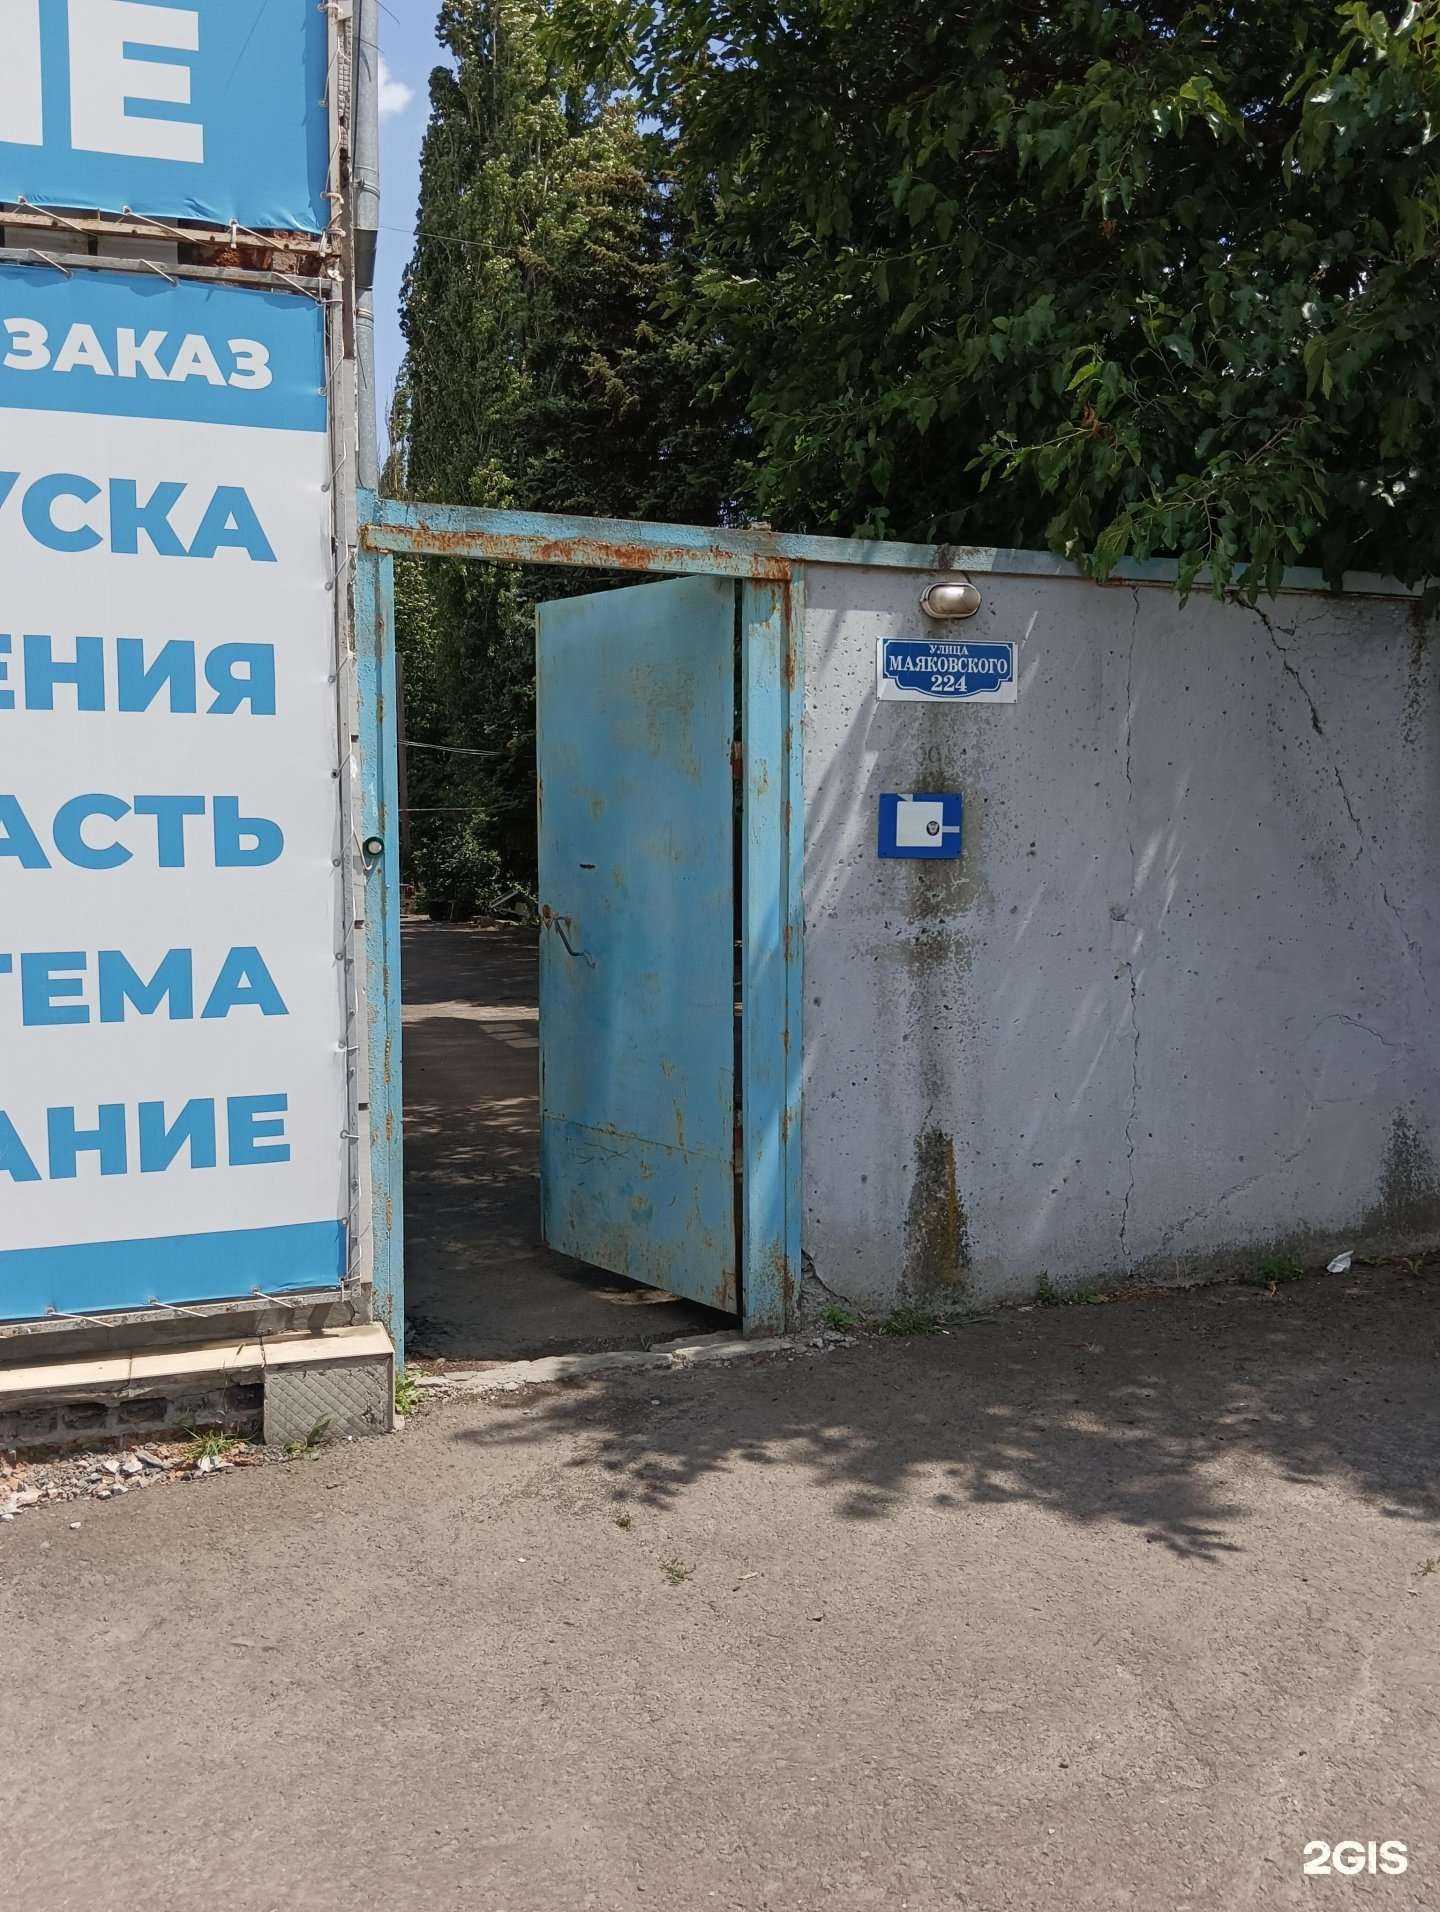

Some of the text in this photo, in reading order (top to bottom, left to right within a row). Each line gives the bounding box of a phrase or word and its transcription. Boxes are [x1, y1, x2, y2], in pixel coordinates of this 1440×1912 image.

[0, 0, 204, 164] Е
[3, 317, 273, 390] ЗАКАЗ
[0, 471, 278, 562] СКА
[0, 634, 277, 716] НИЯ
[889, 655, 1008, 674] МАЯКОВСКОГО
[929, 644, 969, 655] УЛИЦА
[930, 675, 967, 691] 224
[0, 947, 290, 1026] ЕМА
